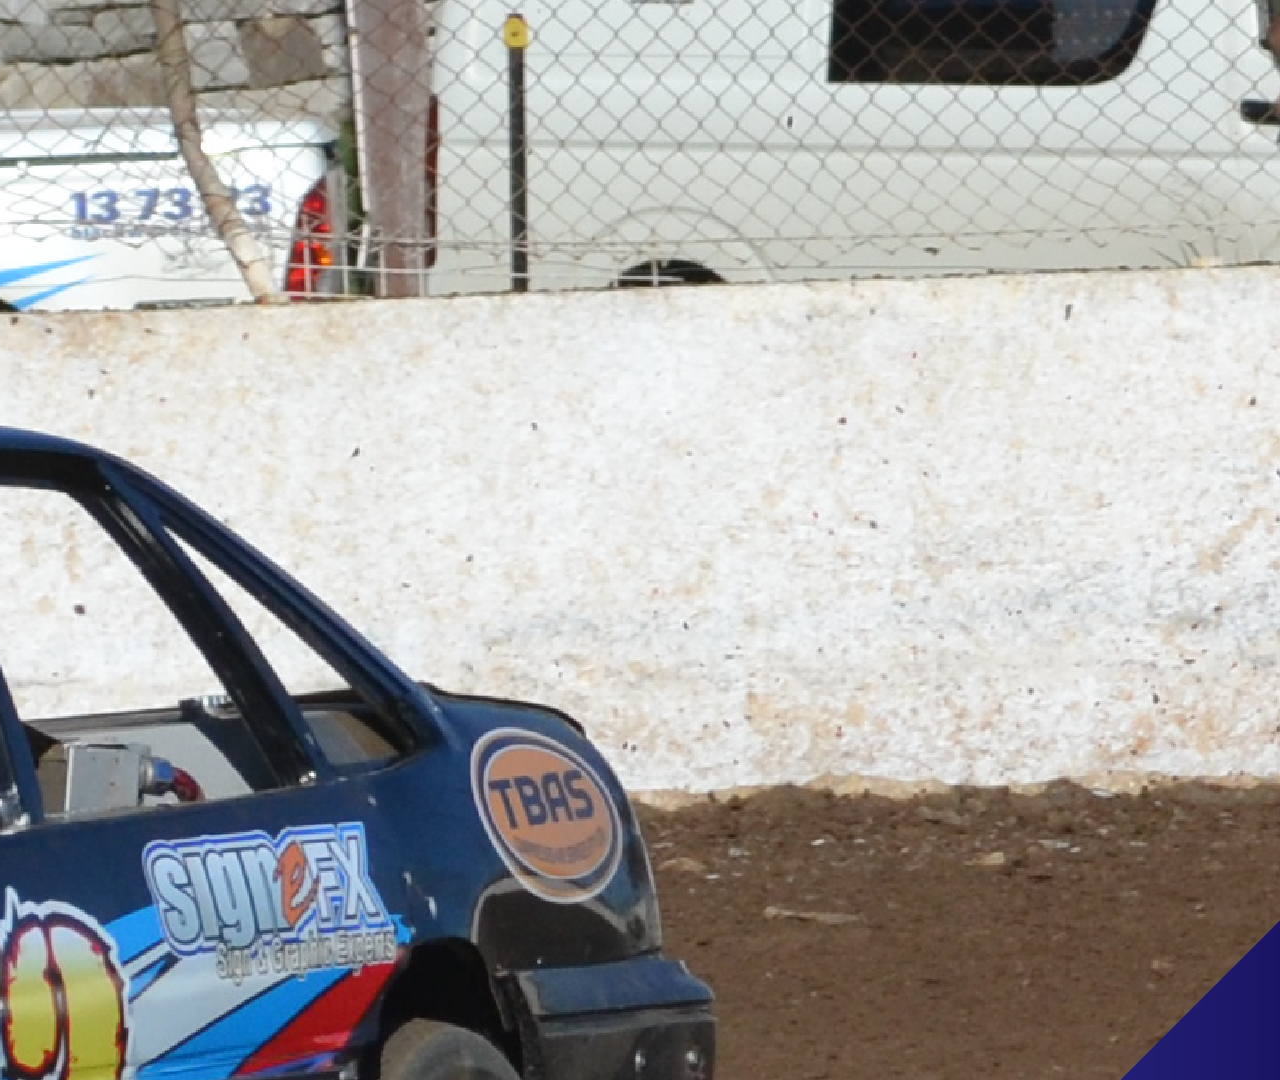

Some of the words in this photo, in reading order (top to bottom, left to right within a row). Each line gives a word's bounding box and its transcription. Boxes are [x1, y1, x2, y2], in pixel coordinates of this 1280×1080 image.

[69, 188, 121, 223] 13
[133, 186, 193, 220] 73
[487, 769, 594, 830] TBAS
